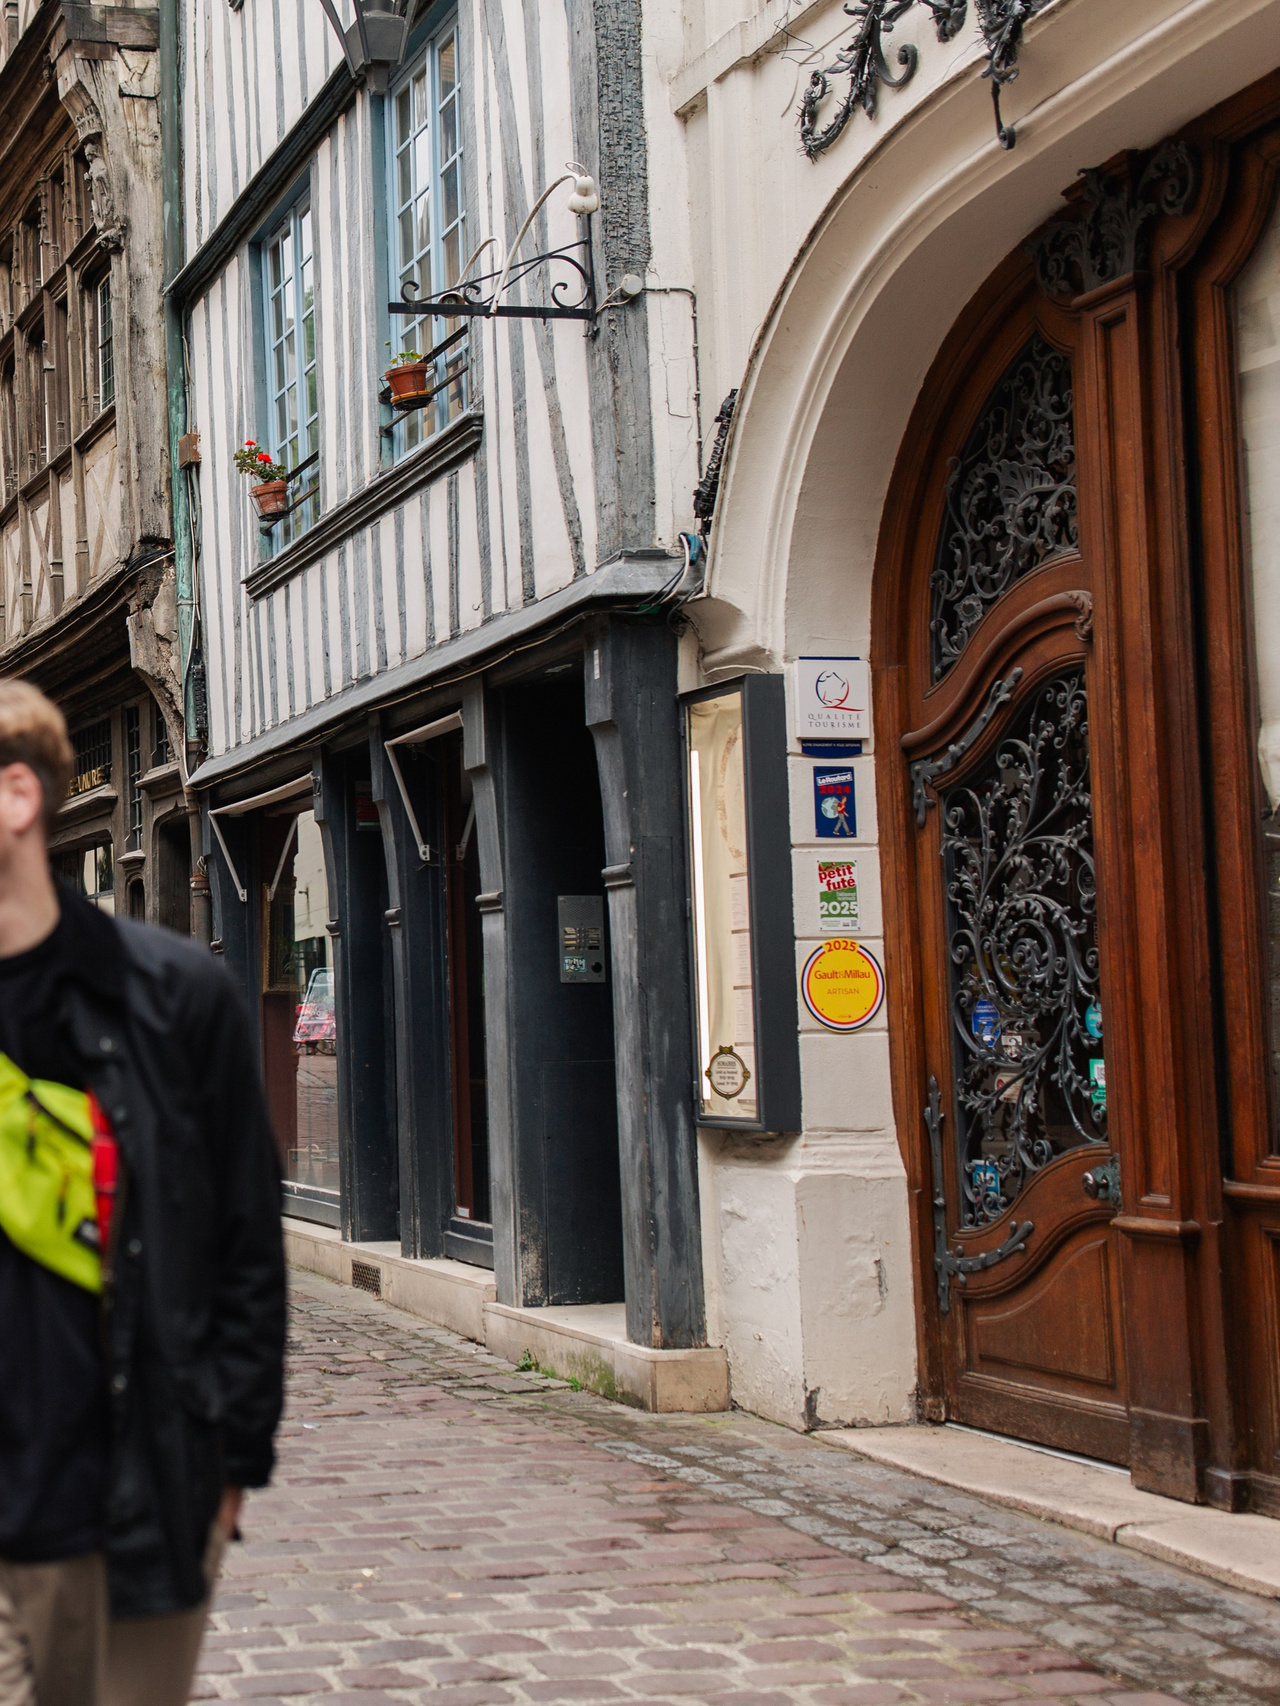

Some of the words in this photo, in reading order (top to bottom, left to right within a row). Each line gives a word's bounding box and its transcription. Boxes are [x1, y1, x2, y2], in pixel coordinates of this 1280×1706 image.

[808, 713, 860, 721] QUALITÉ
[819, 785, 851, 794] 2024
[818, 864, 853, 883] petit
[826, 876, 856, 891] futé
[820, 901, 858, 914] 2025
[825, 940, 856, 952] 2025
[814, 970, 871, 980] Gault&Millau
